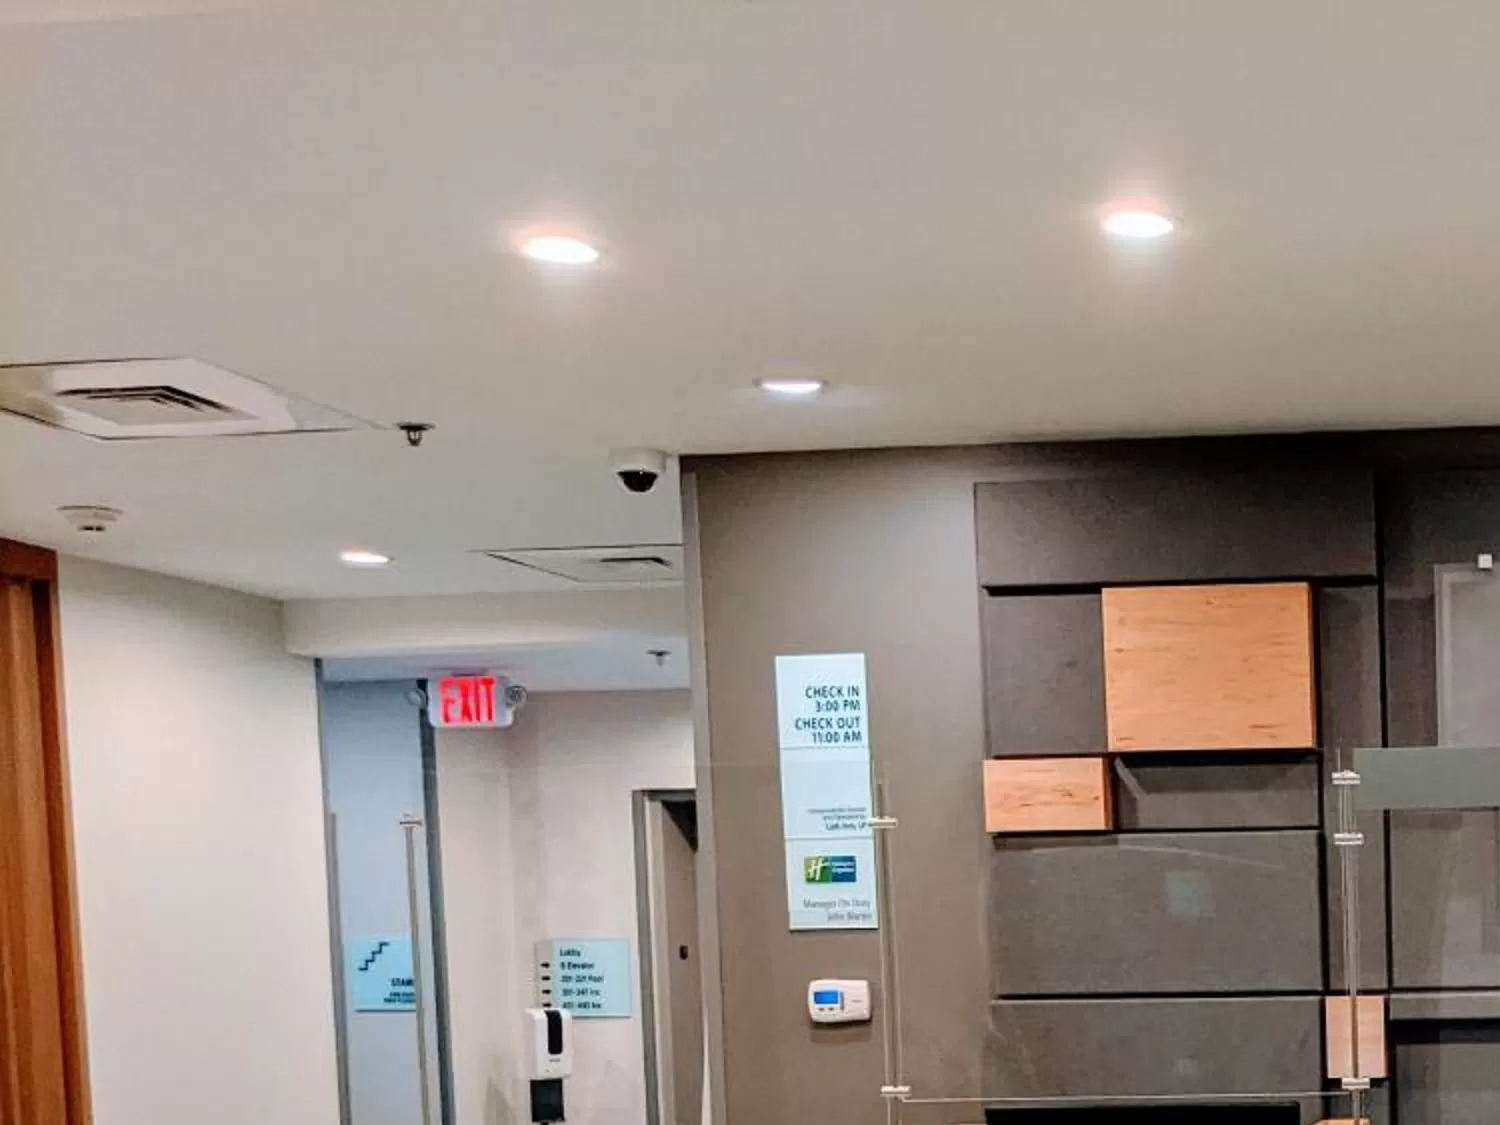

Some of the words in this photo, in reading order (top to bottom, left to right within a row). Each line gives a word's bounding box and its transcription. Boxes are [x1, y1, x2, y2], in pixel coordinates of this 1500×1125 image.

[804, 685, 845, 699] CHECK
[847, 685, 860, 697] IN
[440, 677, 495, 723] EXIT
[843, 699, 861, 711] PM
[795, 716, 834, 731] CHECK
[838, 715, 861, 729] OUT
[843, 730, 863, 743] AM
